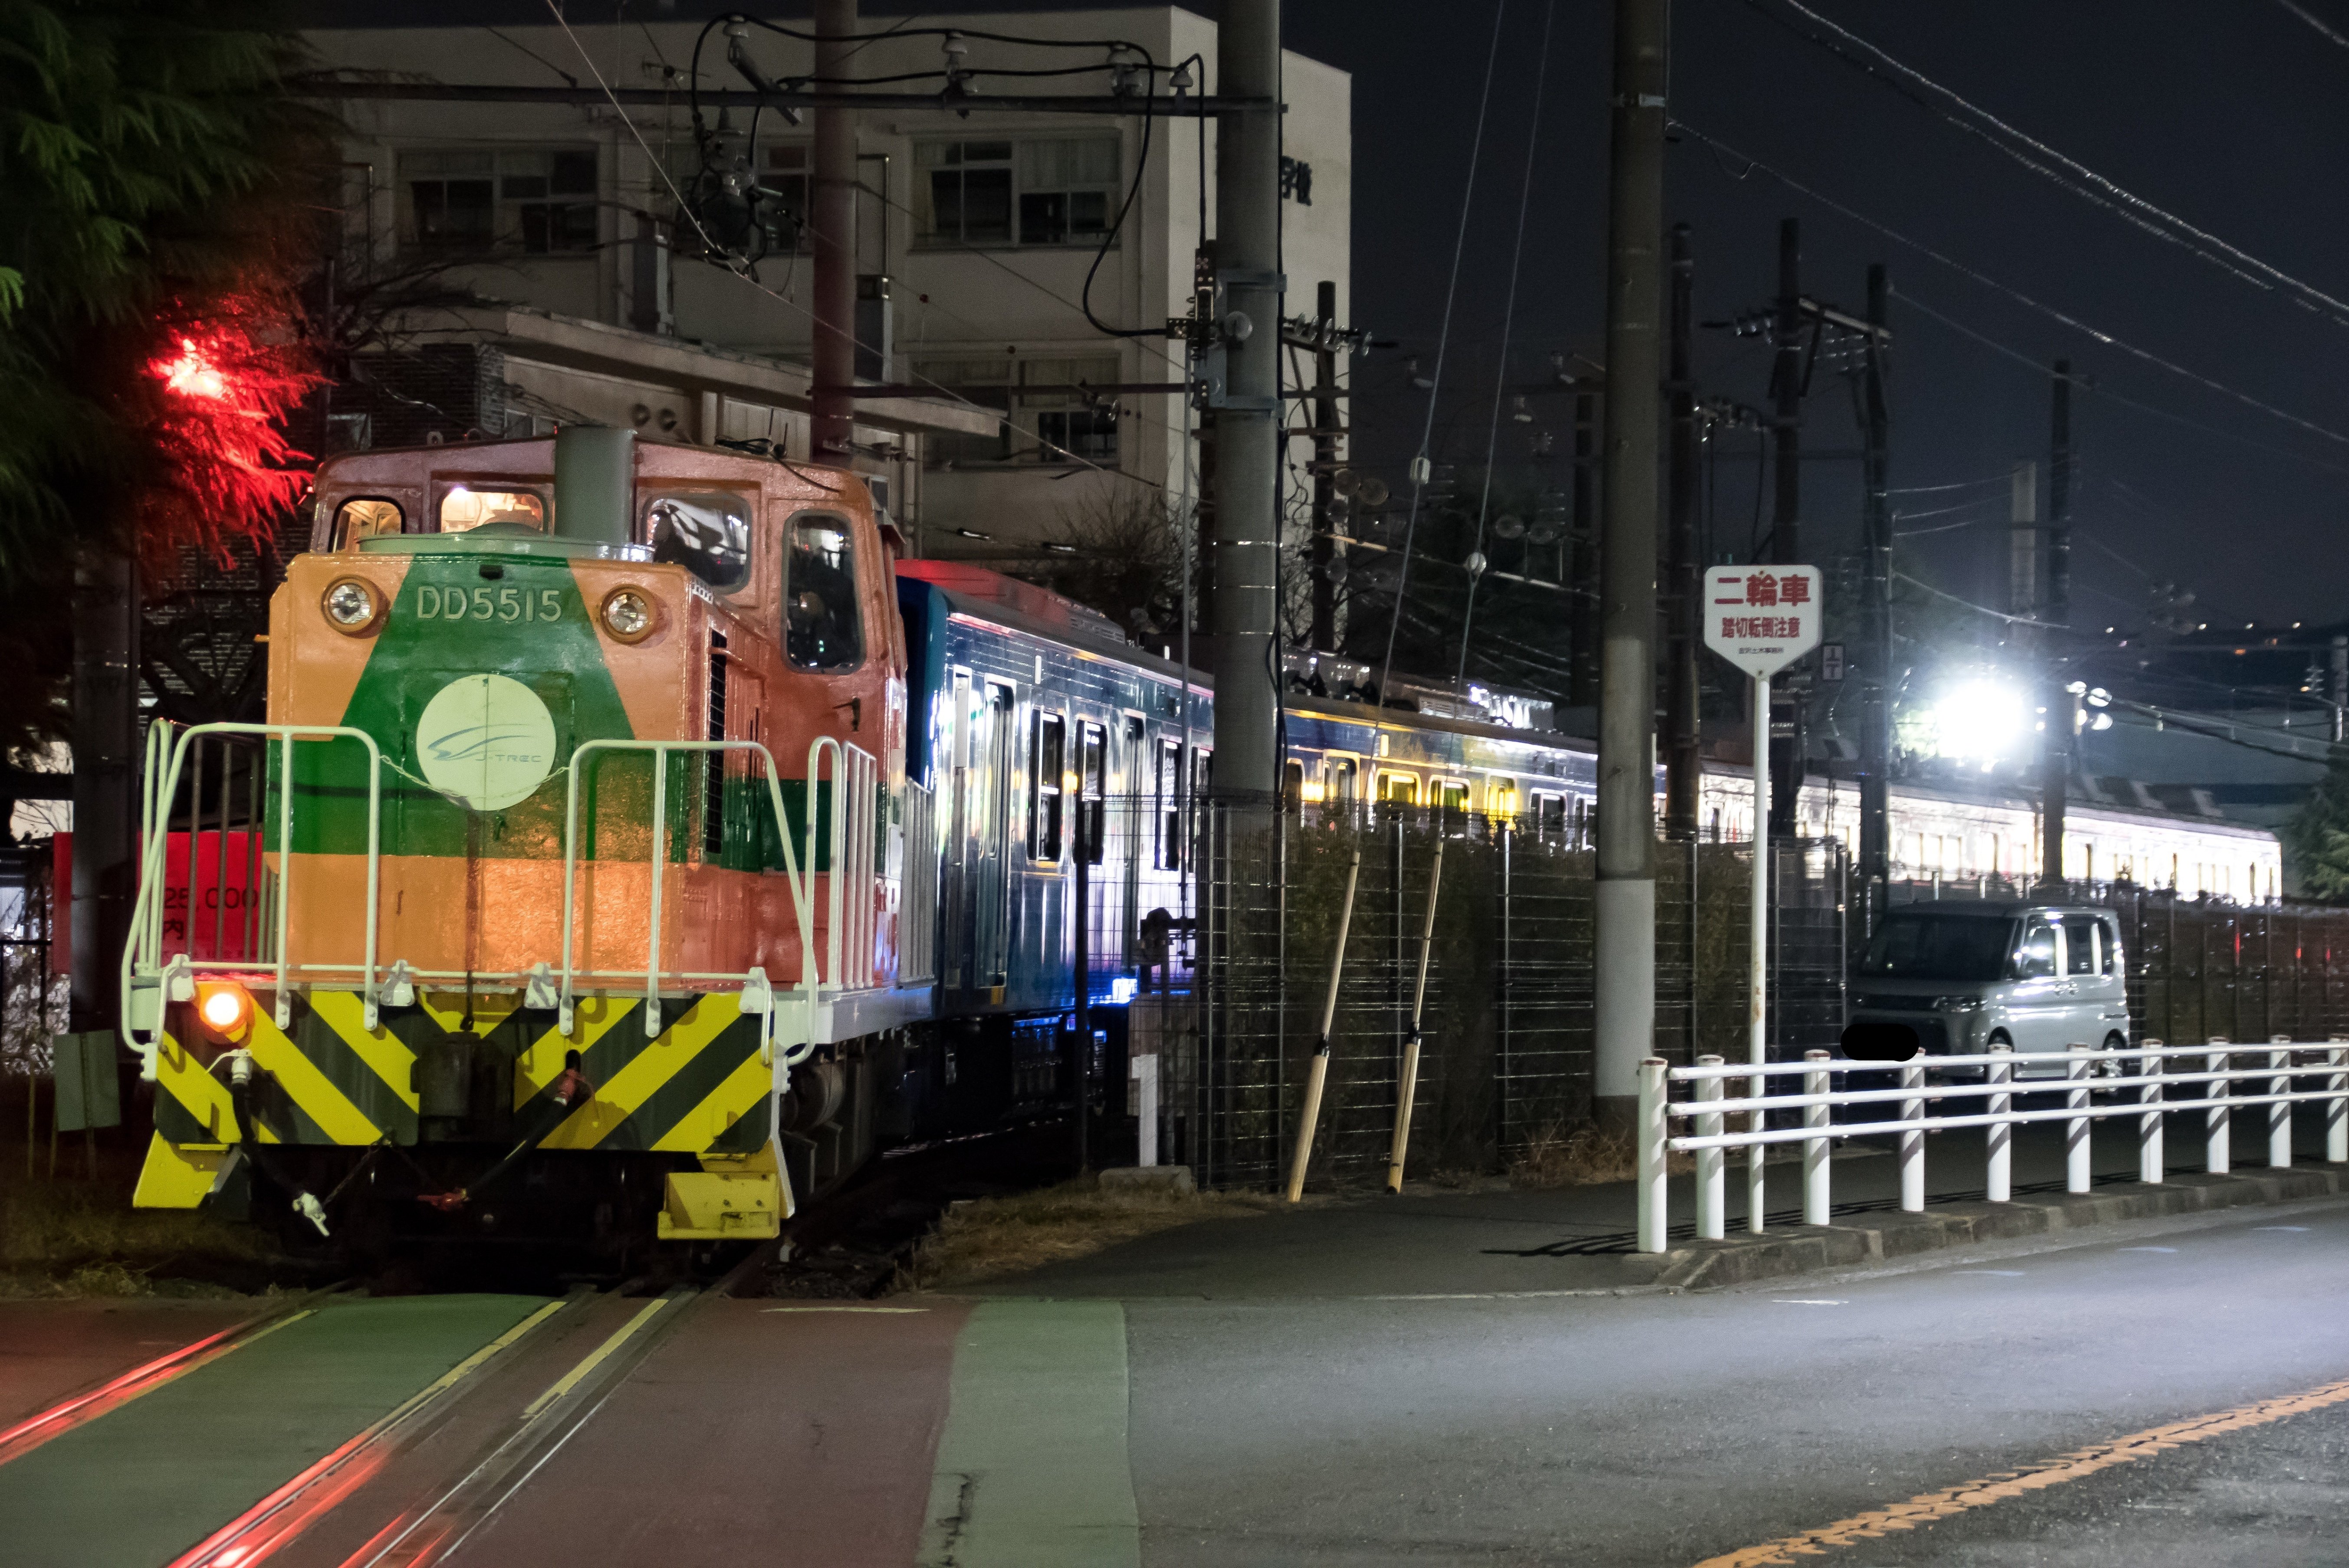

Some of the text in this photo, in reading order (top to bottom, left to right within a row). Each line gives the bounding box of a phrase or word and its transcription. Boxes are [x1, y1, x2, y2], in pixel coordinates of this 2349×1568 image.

[417, 586, 562, 622] DD5515
[1715, 574, 1811, 607] 二輪車
[1722, 616, 1800, 638] 踏切転倒注意
[475, 753, 542, 763] J-TREC
